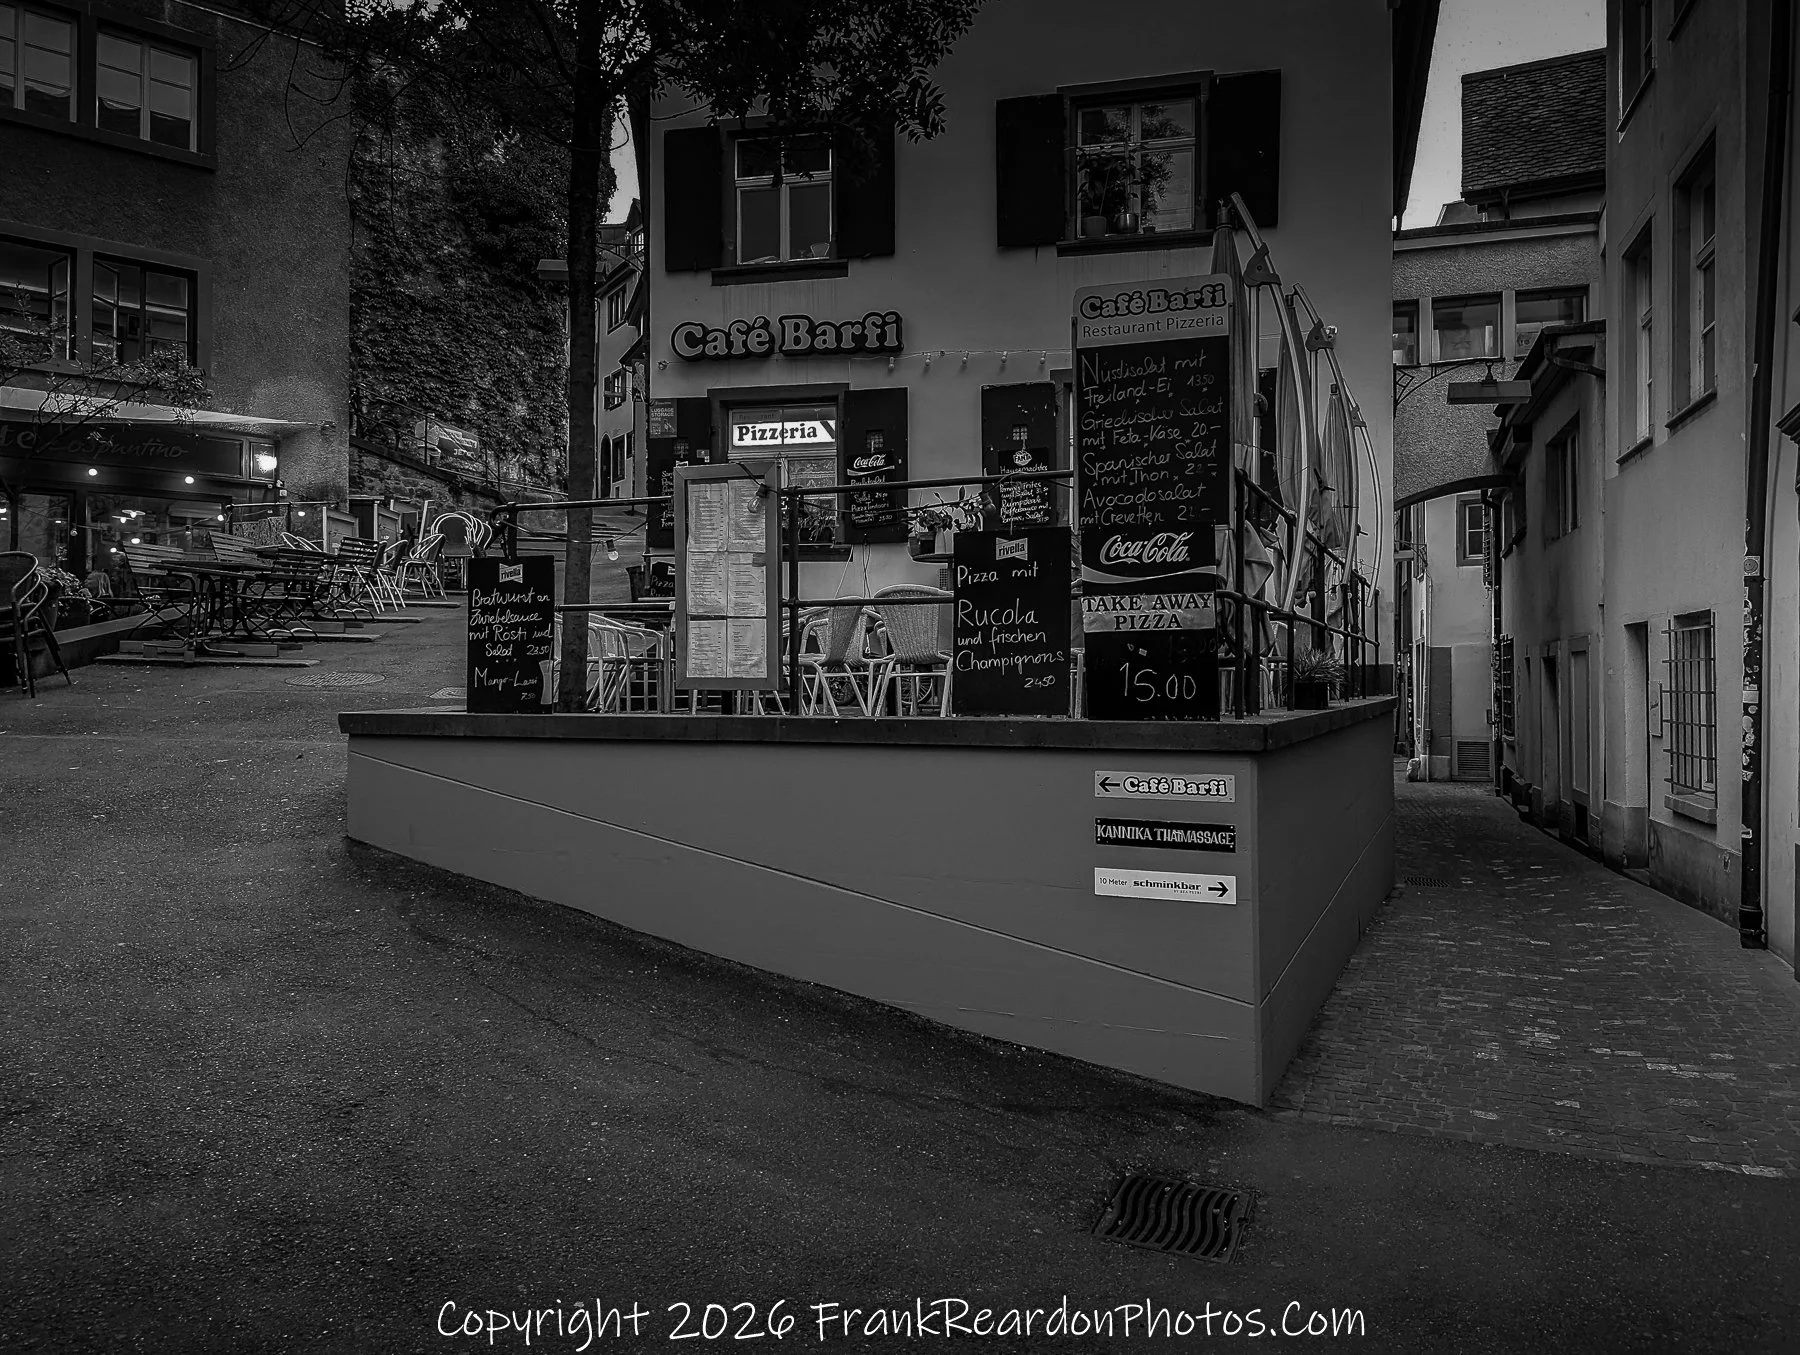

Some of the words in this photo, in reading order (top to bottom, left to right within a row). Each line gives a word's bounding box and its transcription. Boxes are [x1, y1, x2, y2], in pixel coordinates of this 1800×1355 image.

[1080, 291, 1146, 319] Café
[1147, 283, 1227, 313] Barfi
[671, 315, 775, 361] Café
[777, 311, 905, 356] Barfi
[1083, 320, 1161, 338] Restaurant
[1166, 314, 1224, 330] Pizzeria
[1175, 349, 1206, 370] mit
[1083, 377, 1173, 407] Freiland-Ei
[1179, 396, 1223, 416] Salat
[737, 423, 817, 442] Pizzeria
[1083, 431, 1106, 446] mit
[1083, 450, 1171, 480] Spanischer
[1175, 438, 1217, 459] Salat
[1101, 470, 1127, 486] mit
[1130, 467, 1169, 484] Thon
[1083, 482, 1206, 509] Avocadosalat
[1080, 510, 1100, 525] mit
[1101, 502, 1164, 525] Crevetten
[999, 542, 1025, 557] rivella
[957, 565, 999, 587] Pizza
[1012, 560, 1039, 578] mit
[472, 587, 535, 607] Bratwurst
[1082, 595, 1142, 613] TAKE
[1151, 593, 1212, 611] AWAY
[470, 608, 543, 626] Zwiebelsauce
[958, 598, 1039, 628] Rucola
[1114, 614, 1183, 630] PIZZA
[469, 626, 489, 640] mit
[957, 631, 982, 646] und
[989, 626, 1047, 655] frischen
[485, 643, 513, 657] Salat
[956, 650, 1065, 676] Champignons
[1119, 662, 1196, 702] 15.00
[1123, 776, 1170, 794] Café
[1171, 777, 1227, 797] Barfi
[1096, 824, 1153, 841] KANNIKA
[1099, 877, 1108, 885] 10
[1109, 878, 1128, 886] Meter
[1133, 879, 1202, 891] schminkbar
